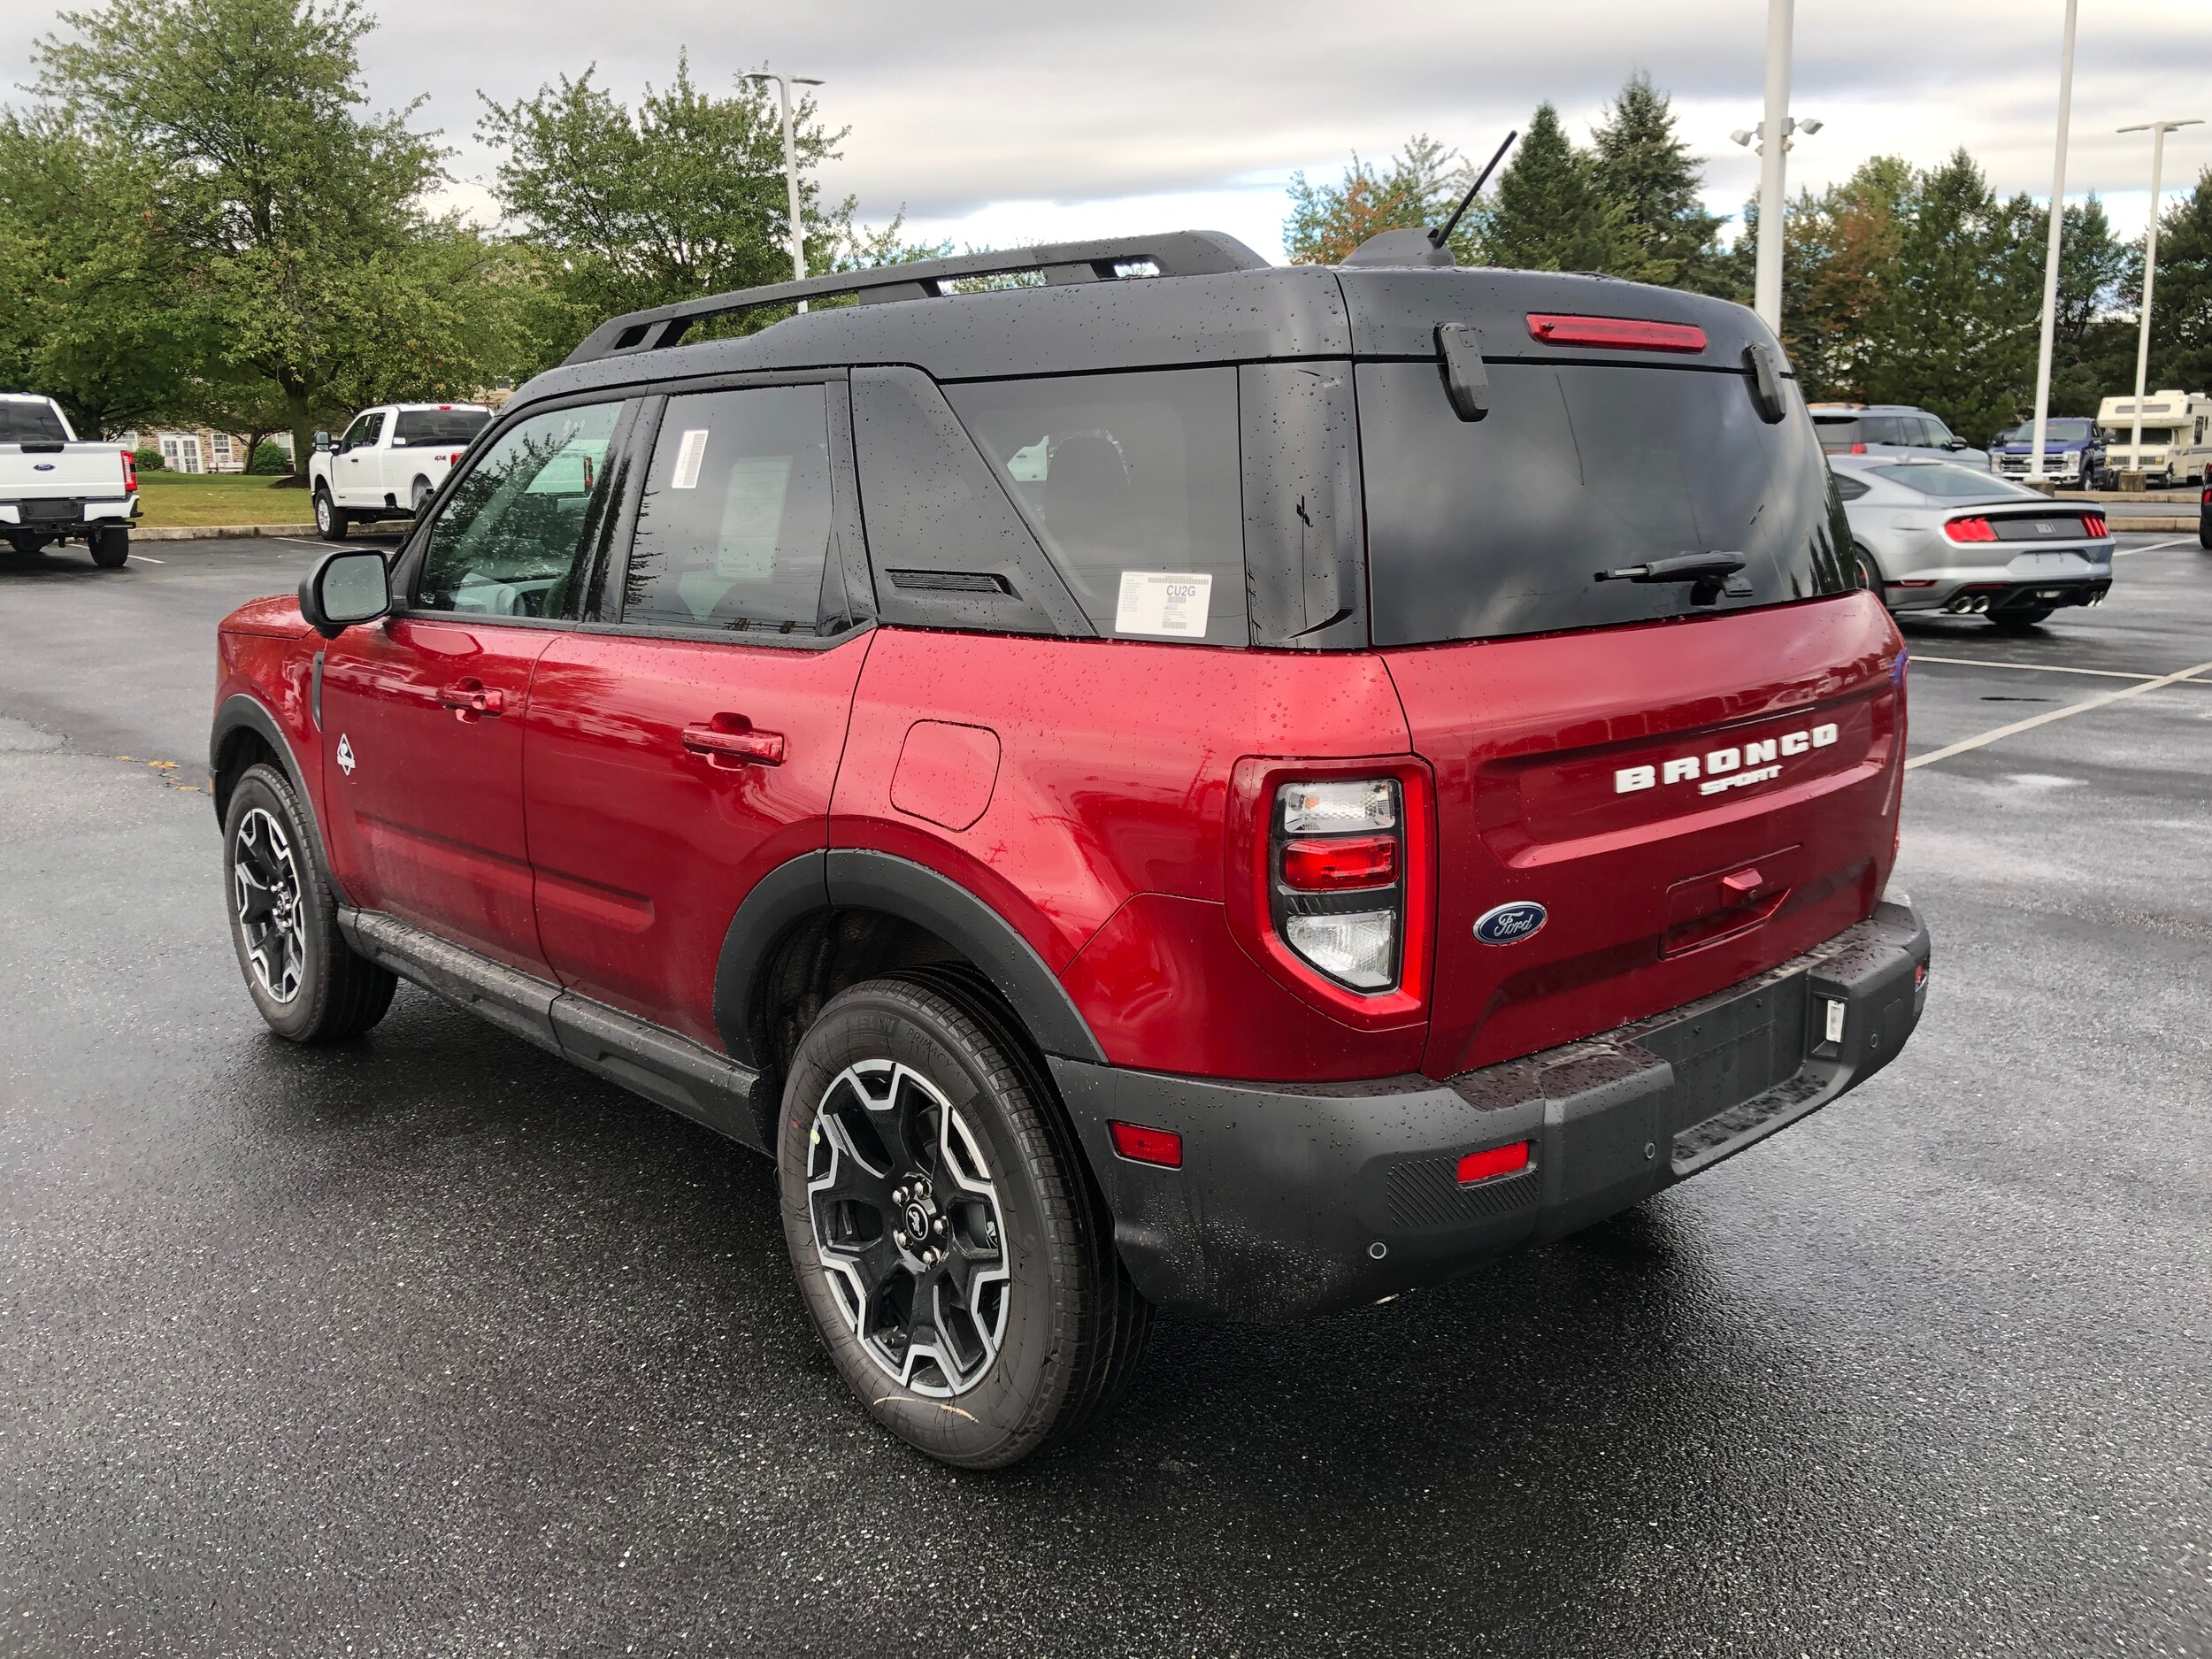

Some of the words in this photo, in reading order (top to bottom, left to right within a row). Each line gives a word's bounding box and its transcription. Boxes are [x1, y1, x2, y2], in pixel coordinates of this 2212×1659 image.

[1166, 585, 1195, 596] CU2G
[1615, 723, 1839, 794] BRONCO
[1698, 764, 1783, 795] SPORT
[1494, 910, 1533, 936] Ford
[907, 1027, 953, 1067] PRIMACY
